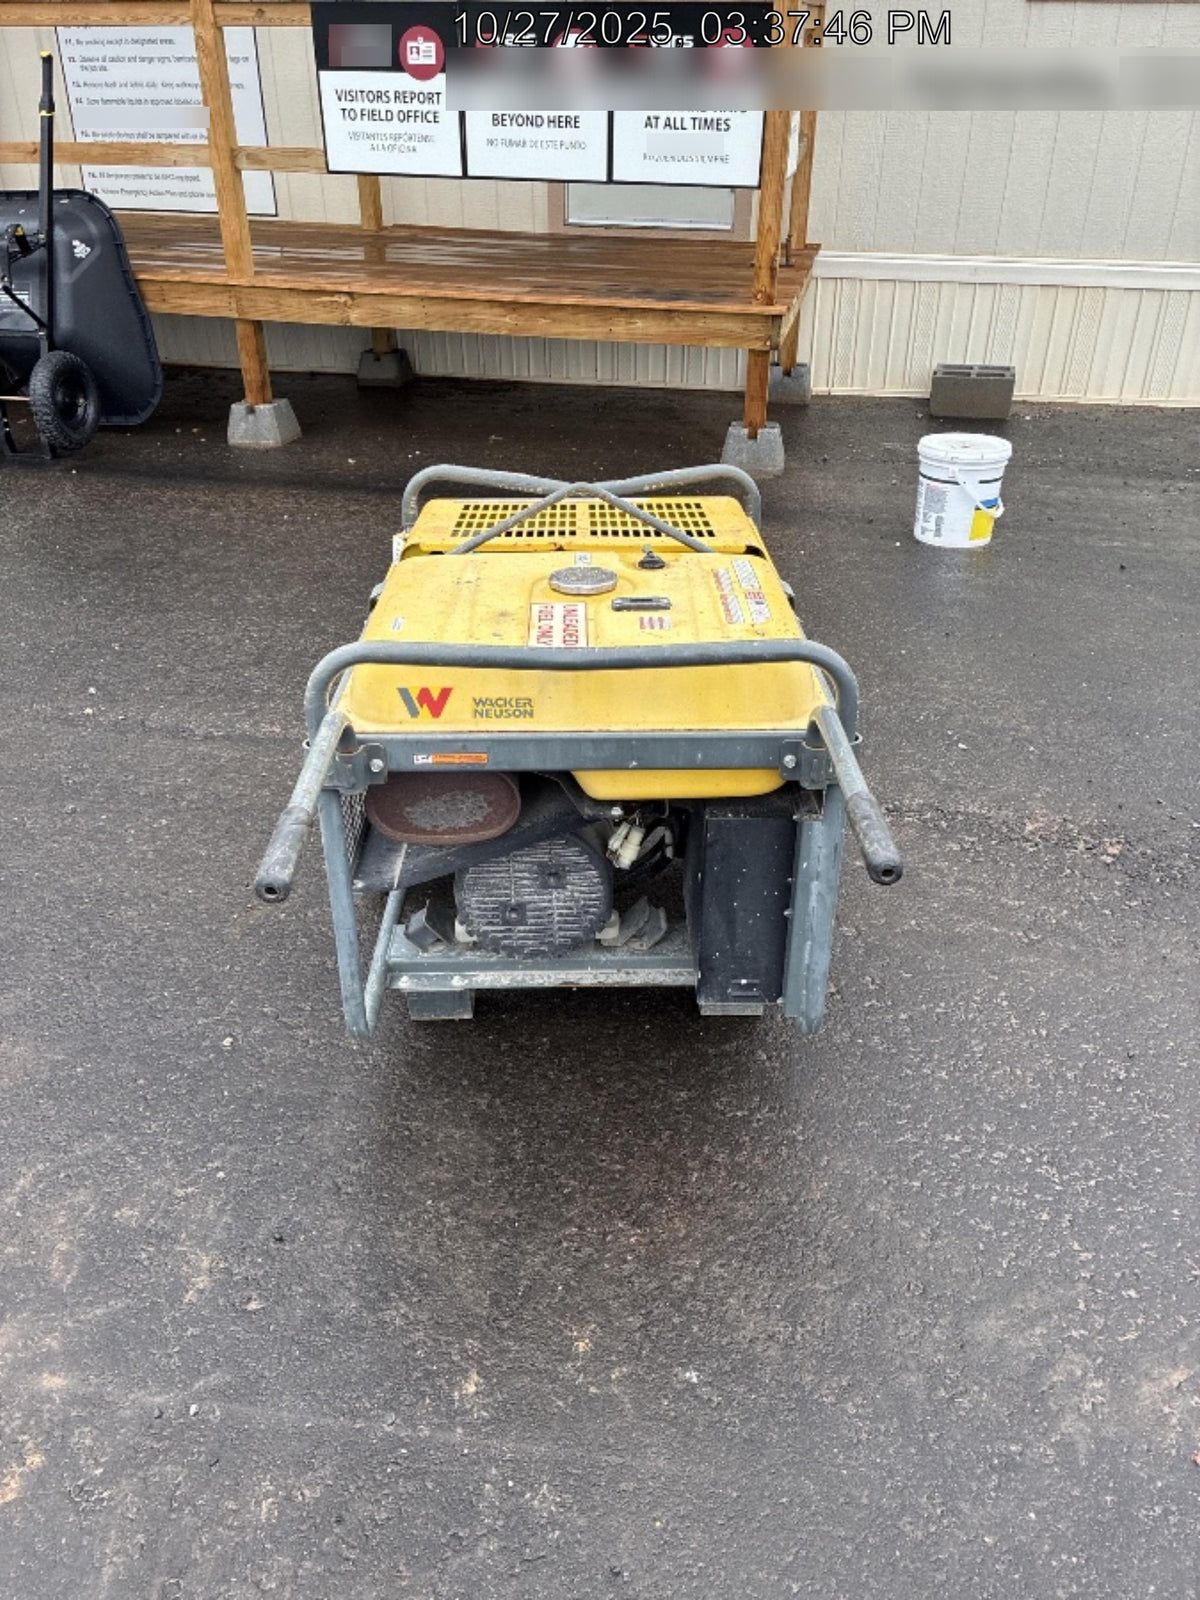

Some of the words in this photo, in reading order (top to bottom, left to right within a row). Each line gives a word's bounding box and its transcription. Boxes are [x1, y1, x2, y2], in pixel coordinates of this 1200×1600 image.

[335, 89, 391, 104] VISITORS
[394, 90, 442, 105] REPORT
[341, 108, 358, 121] TO
[360, 108, 393, 122] FIELD
[397, 109, 440, 123] OFFICE
[491, 113, 544, 128] BEYOND
[547, 115, 580, 129] HERE
[644, 115, 660, 129] AT
[663, 116, 687, 131] ALL
[690, 117, 731, 132] TIMES
[538, 604, 554, 623] FUEL
[562, 604, 579, 646] UNLEADED
[472, 697, 534, 708] WACKER
[473, 708, 534, 719] NEUSON
